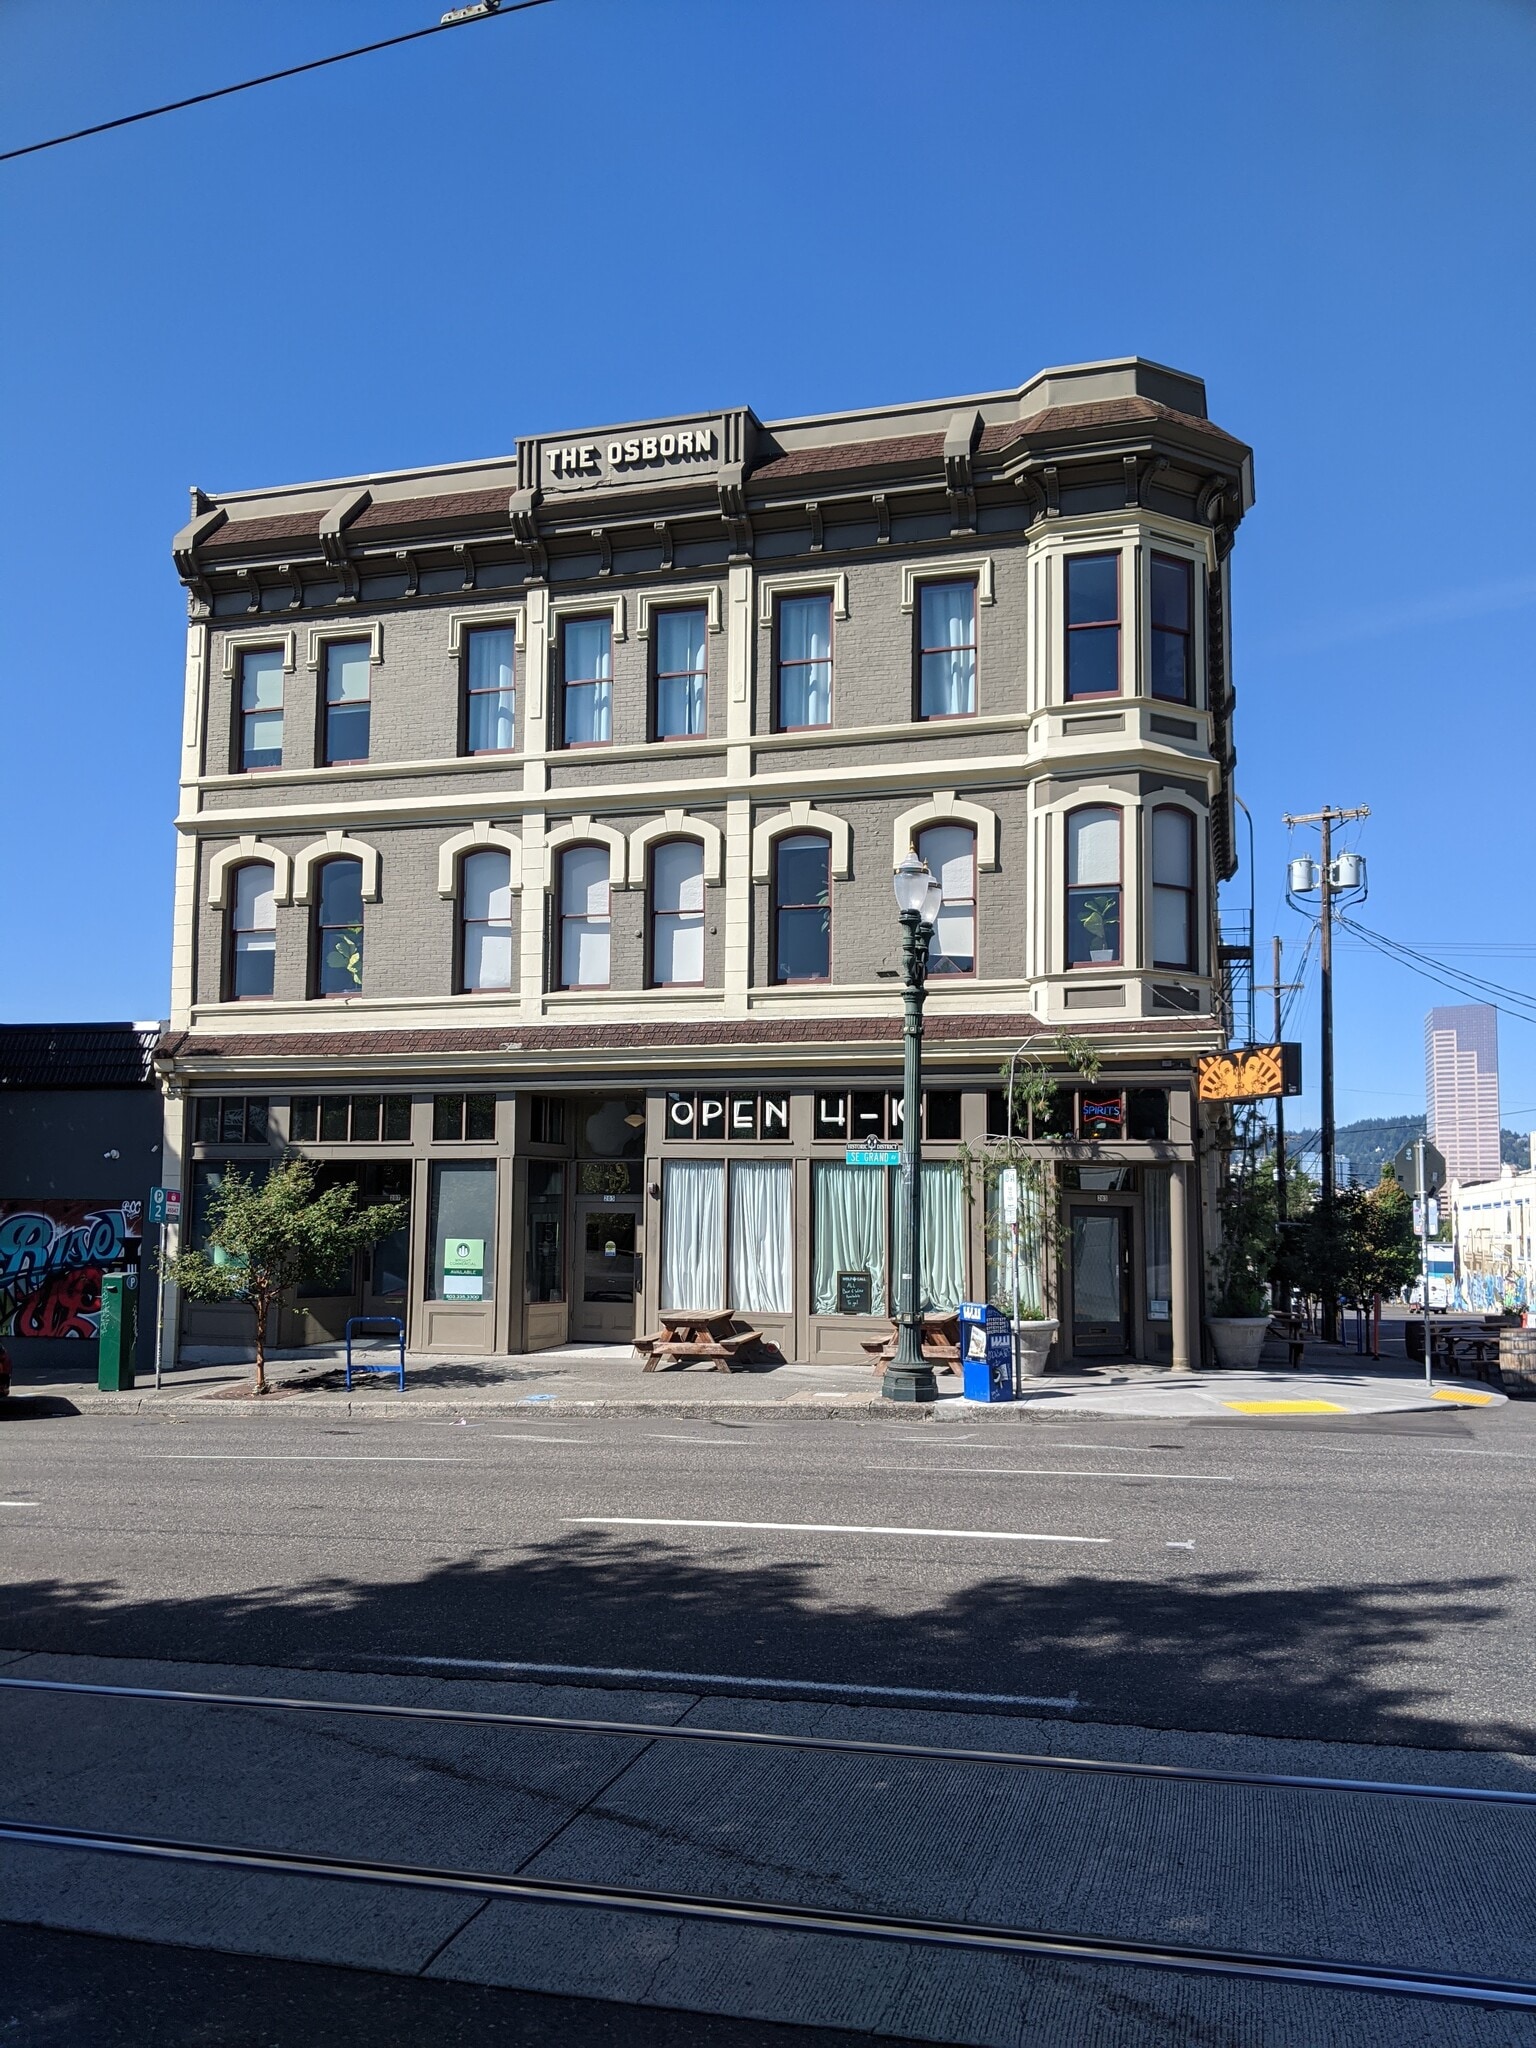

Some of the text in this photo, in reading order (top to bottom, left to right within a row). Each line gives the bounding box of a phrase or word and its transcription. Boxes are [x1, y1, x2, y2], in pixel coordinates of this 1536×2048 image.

[546, 429, 711, 471] THE OSBORN
[671, 1100, 787, 1128] OPEN
[1083, 1106, 1120, 1116] SPIRITS
[851, 1152, 860, 1162] SE
[864, 1152, 889, 1162] GRAND
[155, 1205, 162, 1217] 2
